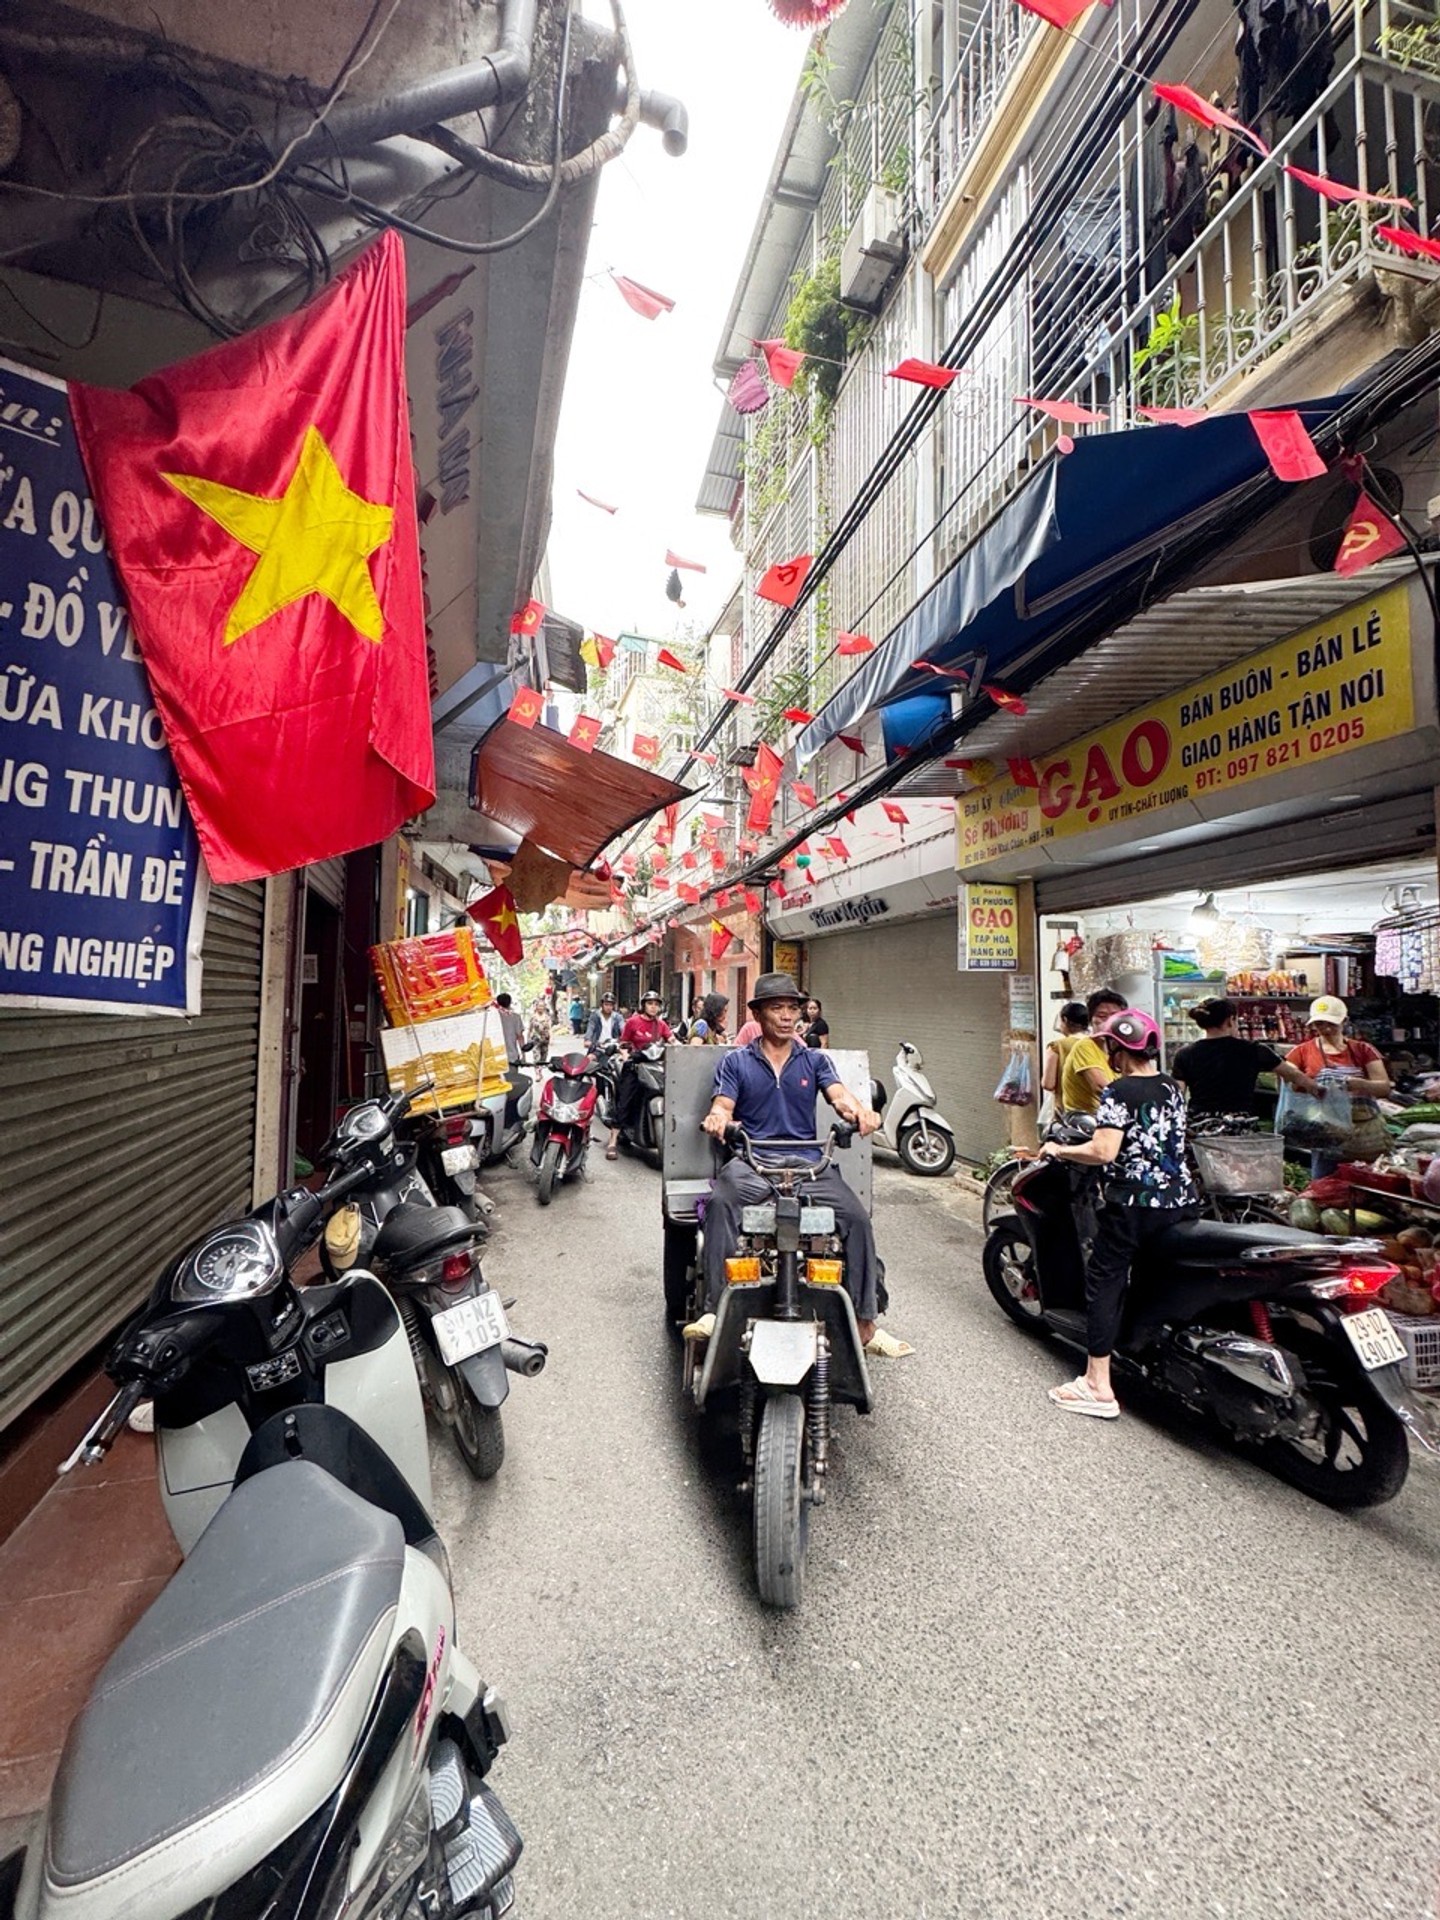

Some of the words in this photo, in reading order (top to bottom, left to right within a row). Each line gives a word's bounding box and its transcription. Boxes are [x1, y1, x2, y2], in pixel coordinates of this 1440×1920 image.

[0, 388, 62, 437] n:
[48, 491, 105, 559] QU
[21, 566, 84, 647] ĐỒ
[1180, 693, 1214, 728] BÁN
[1220, 666, 1273, 711] BUÔN
[1297, 634, 1343, 678] BÁN
[1353, 609, 1382, 654] LẺ
[1181, 734, 1221, 767] GIAO
[1228, 710, 1281, 752] HÀNG
[1287, 690, 1331, 729] TẬN
[1340, 668, 1385, 711] NƠI
[1195, 768, 1222, 790] ĐT:
[1227, 753, 1260, 780] 097
[1266, 739, 1300, 767] 821
[1309, 716, 1365, 753] 0205
[64, 769, 183, 829] THUN
[1038, 719, 1172, 823] GẠO
[30, 833, 132, 899] TRẦN
[141, 850, 186, 905] ĐÈ
[971, 907, 1013, 934] GẠO
[53, 935, 175, 988] NGHIỆP
